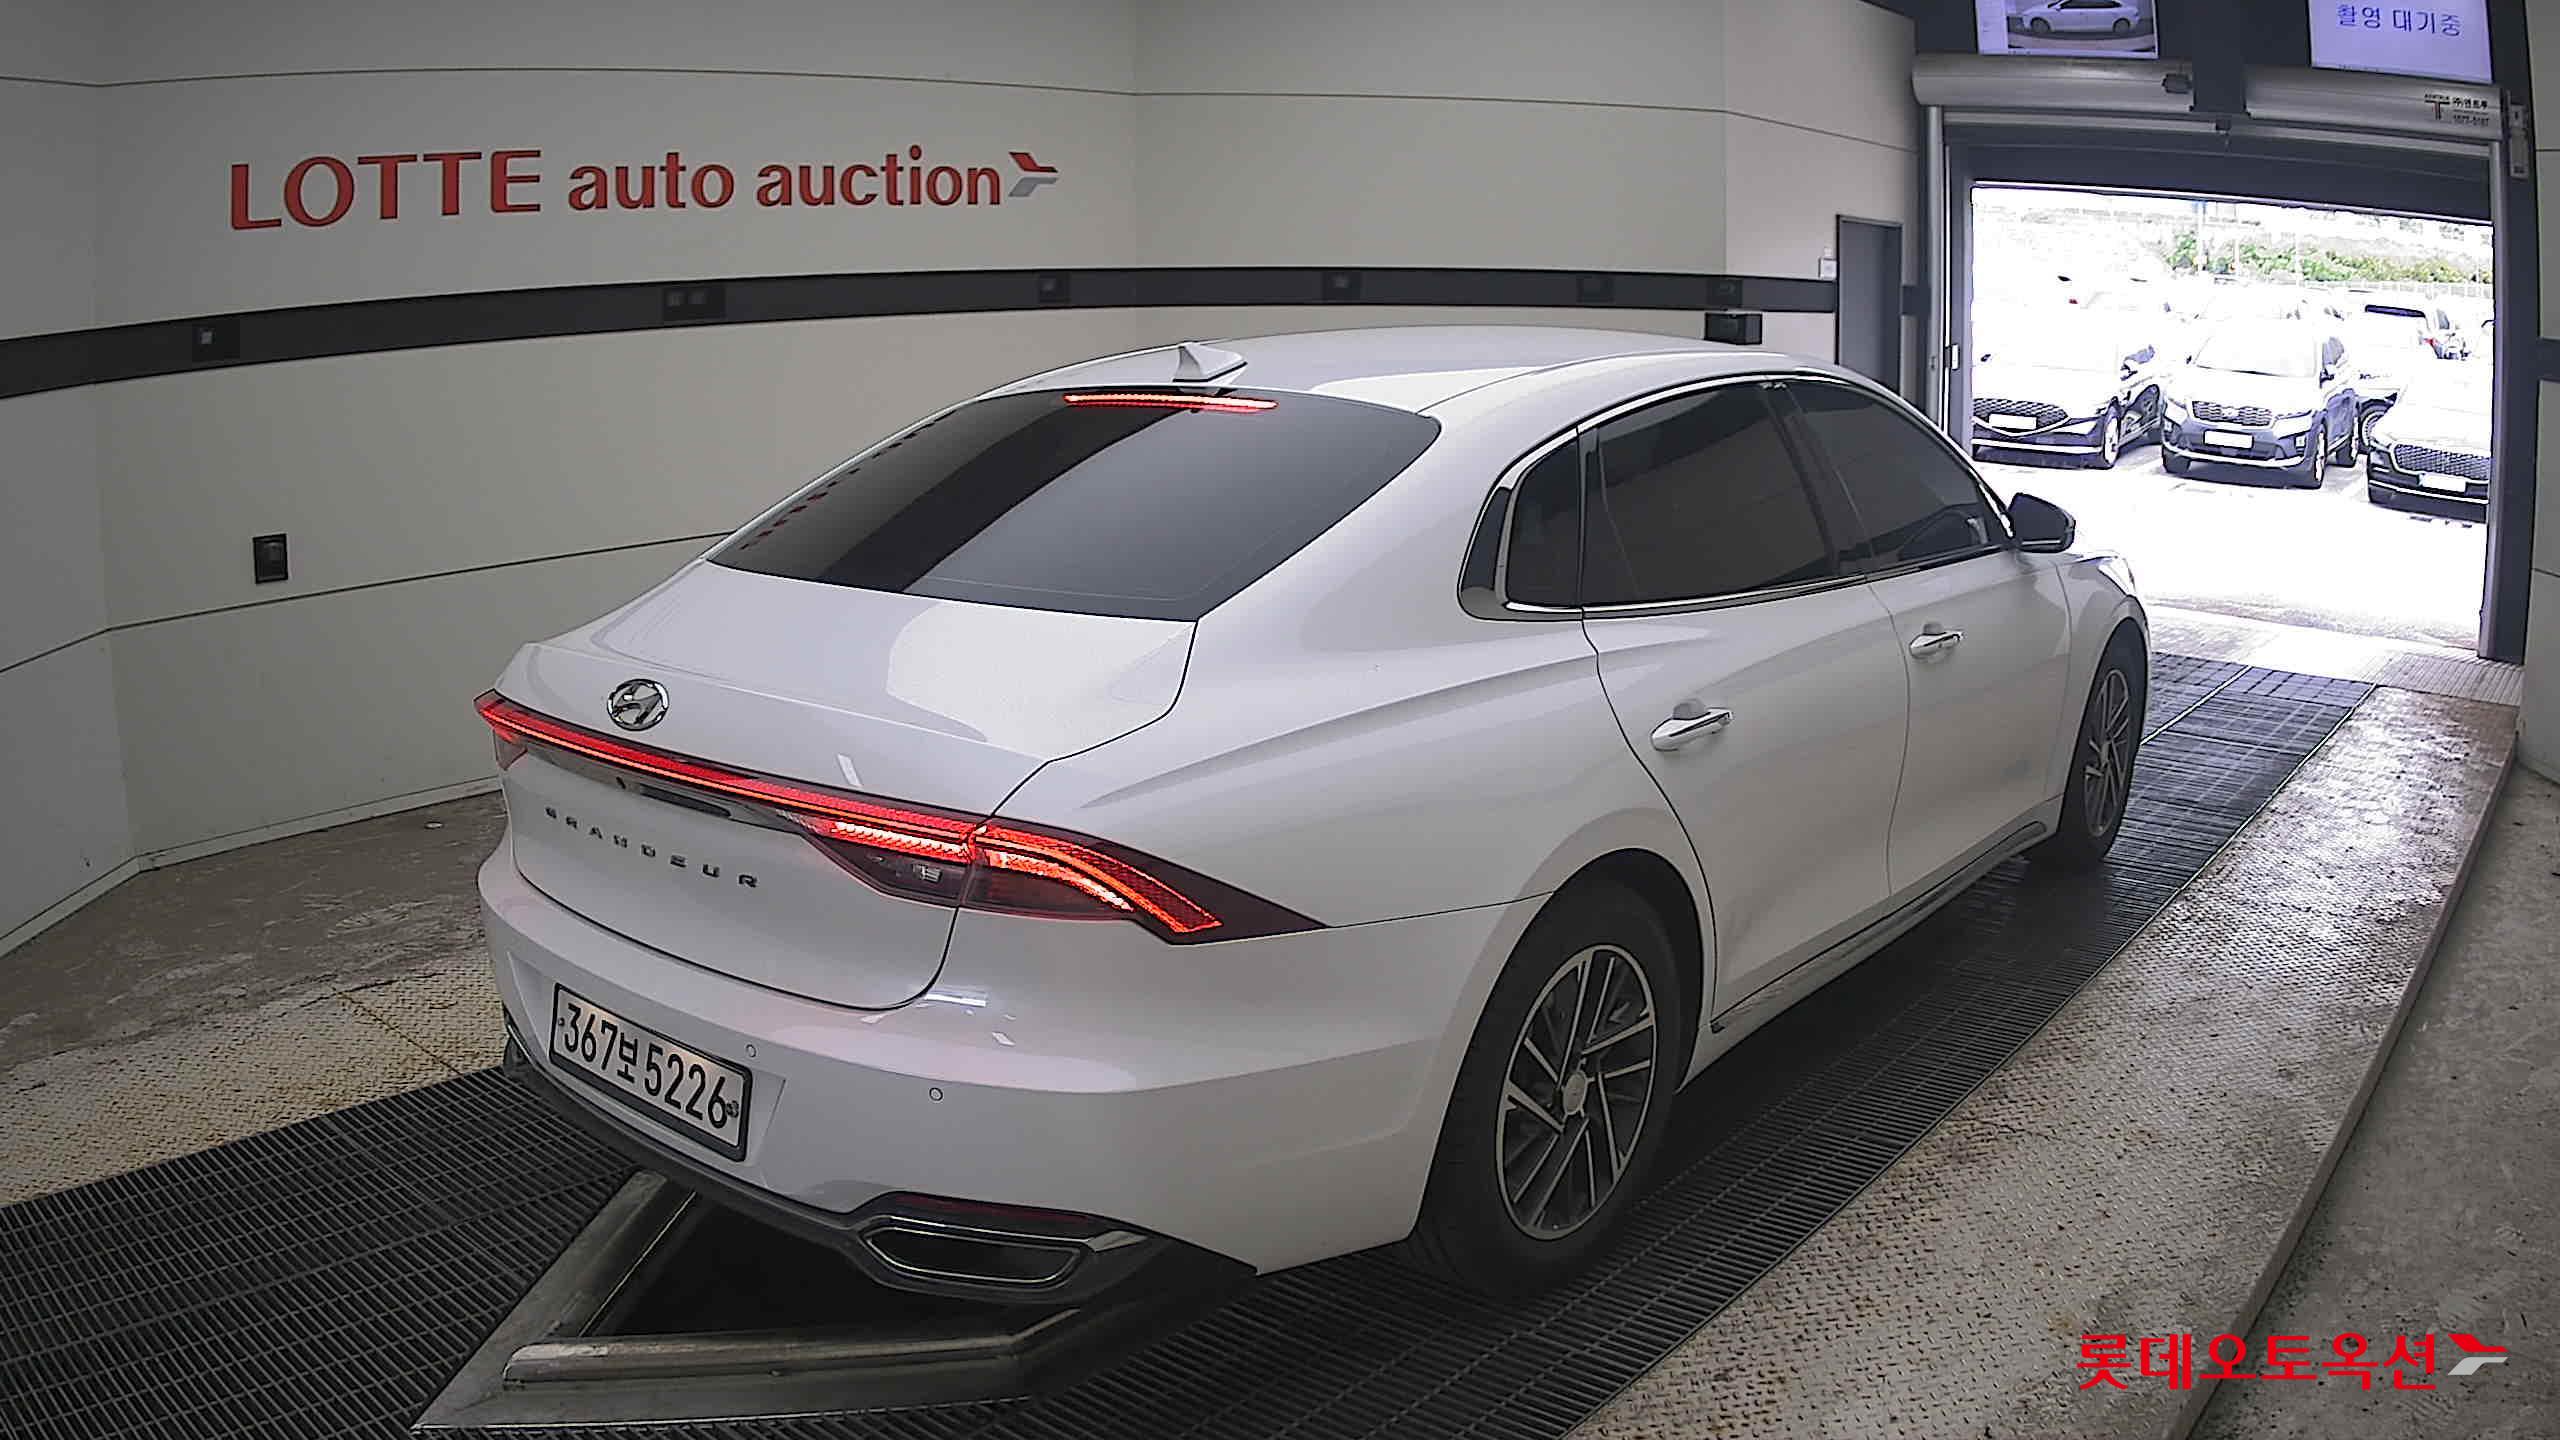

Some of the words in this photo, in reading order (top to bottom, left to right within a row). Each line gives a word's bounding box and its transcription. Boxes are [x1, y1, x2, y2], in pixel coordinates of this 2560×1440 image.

[2338, 4, 2381, 29] 촬영
[2393, 9, 2461, 37] 대기중
[231, 149, 542, 231] LOTTE
[568, 151, 735, 211] auto
[756, 144, 1001, 206] auction
[545, 806, 758, 888] GRANDEUR
